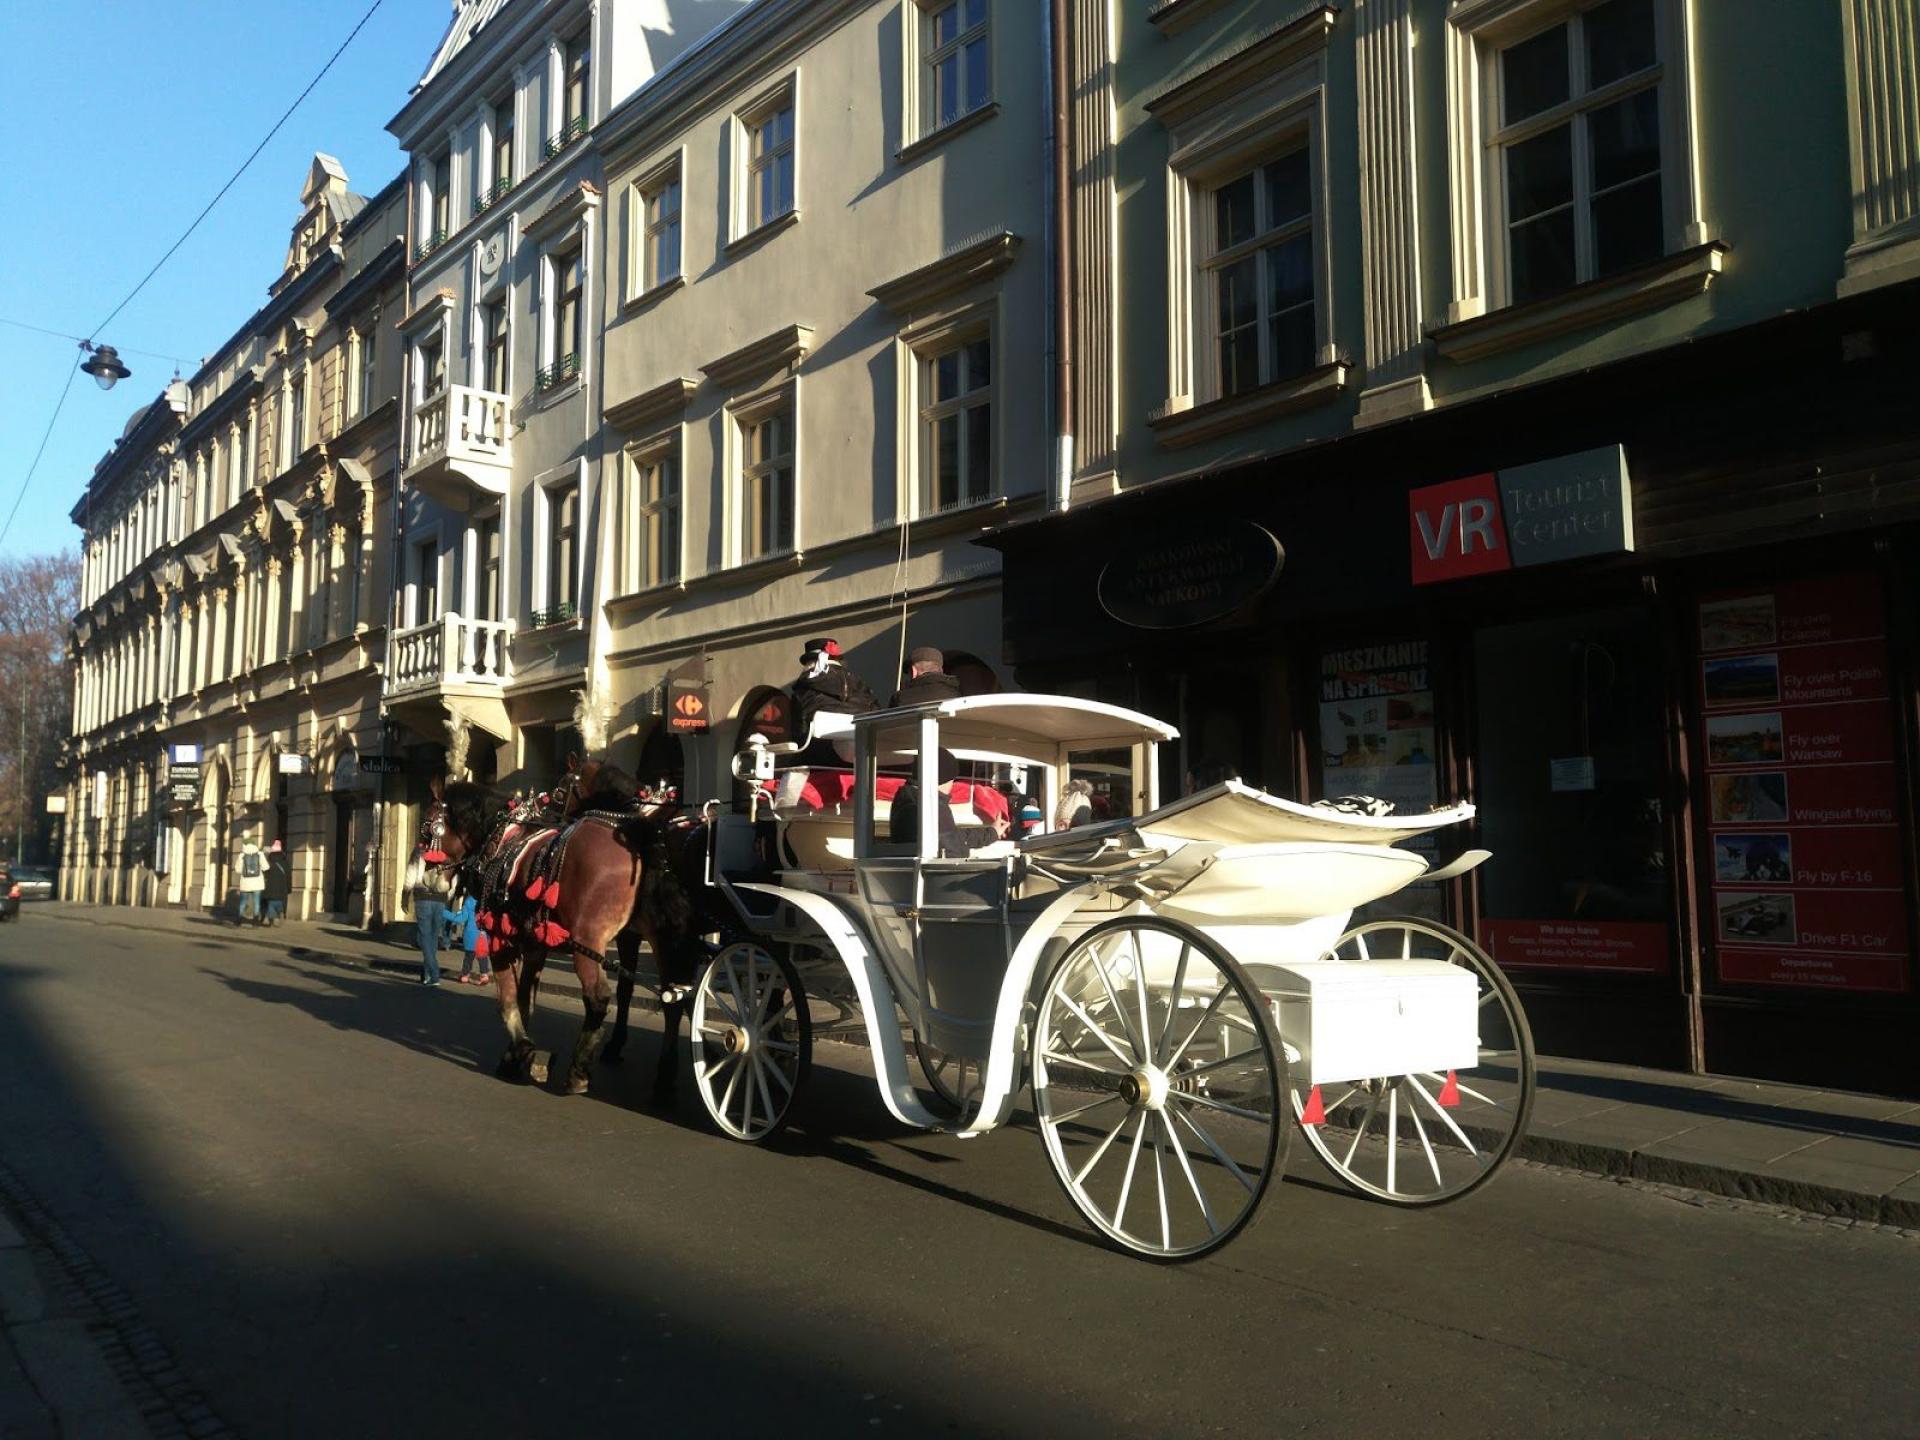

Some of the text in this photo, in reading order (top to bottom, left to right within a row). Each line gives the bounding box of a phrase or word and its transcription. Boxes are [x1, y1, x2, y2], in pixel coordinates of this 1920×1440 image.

[1509, 474, 1609, 514] Tourist
[1415, 497, 1499, 561] VR
[1513, 509, 1612, 545] Center
[1321, 640, 1430, 676] MIESZKANIE
[1784, 667, 1882, 688] Fly over Polish
[1322, 678, 1345, 701] NA
[1784, 687, 1853, 701] Mountains
[672, 718, 706, 729] express
[1789, 734, 1841, 748] Fly over
[1789, 749, 1843, 761] Warsaw
[1794, 807, 1892, 821] Wingsuit flying
[1797, 870, 1873, 885] Fly by F-16
[1801, 932, 1889, 946] Drive F1 Car
[1780, 958, 1833, 968] Departures
